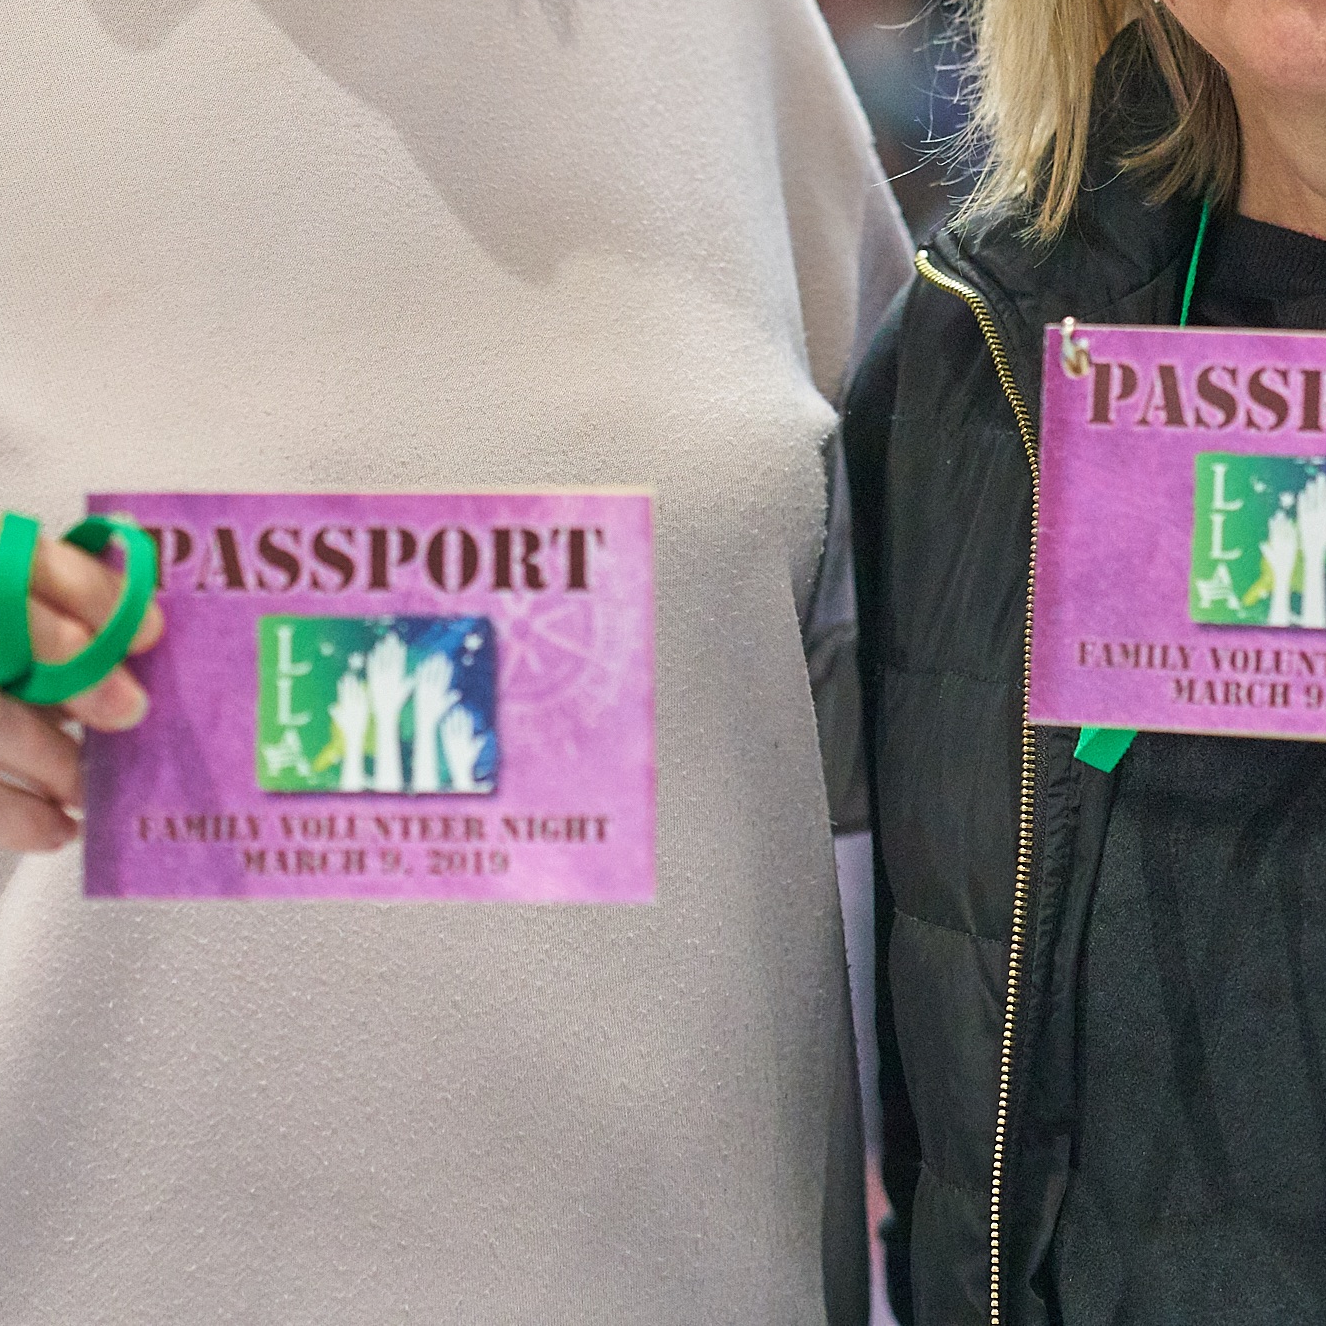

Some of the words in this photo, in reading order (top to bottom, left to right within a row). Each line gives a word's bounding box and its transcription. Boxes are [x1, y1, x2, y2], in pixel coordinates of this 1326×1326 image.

[142, 527, 606, 592] PASSPORT
[1077, 640, 1192, 671] FAMILY
[1173, 677, 1291, 709] MARCH
[137, 813, 261, 842] FAMILY
[280, 813, 487, 843] VOLUNTEER
[500, 813, 610, 843] NIGHT
[243, 847, 367, 875] MARCH
[380, 847, 414, 876] 9,
[427, 847, 510, 875] 2019
